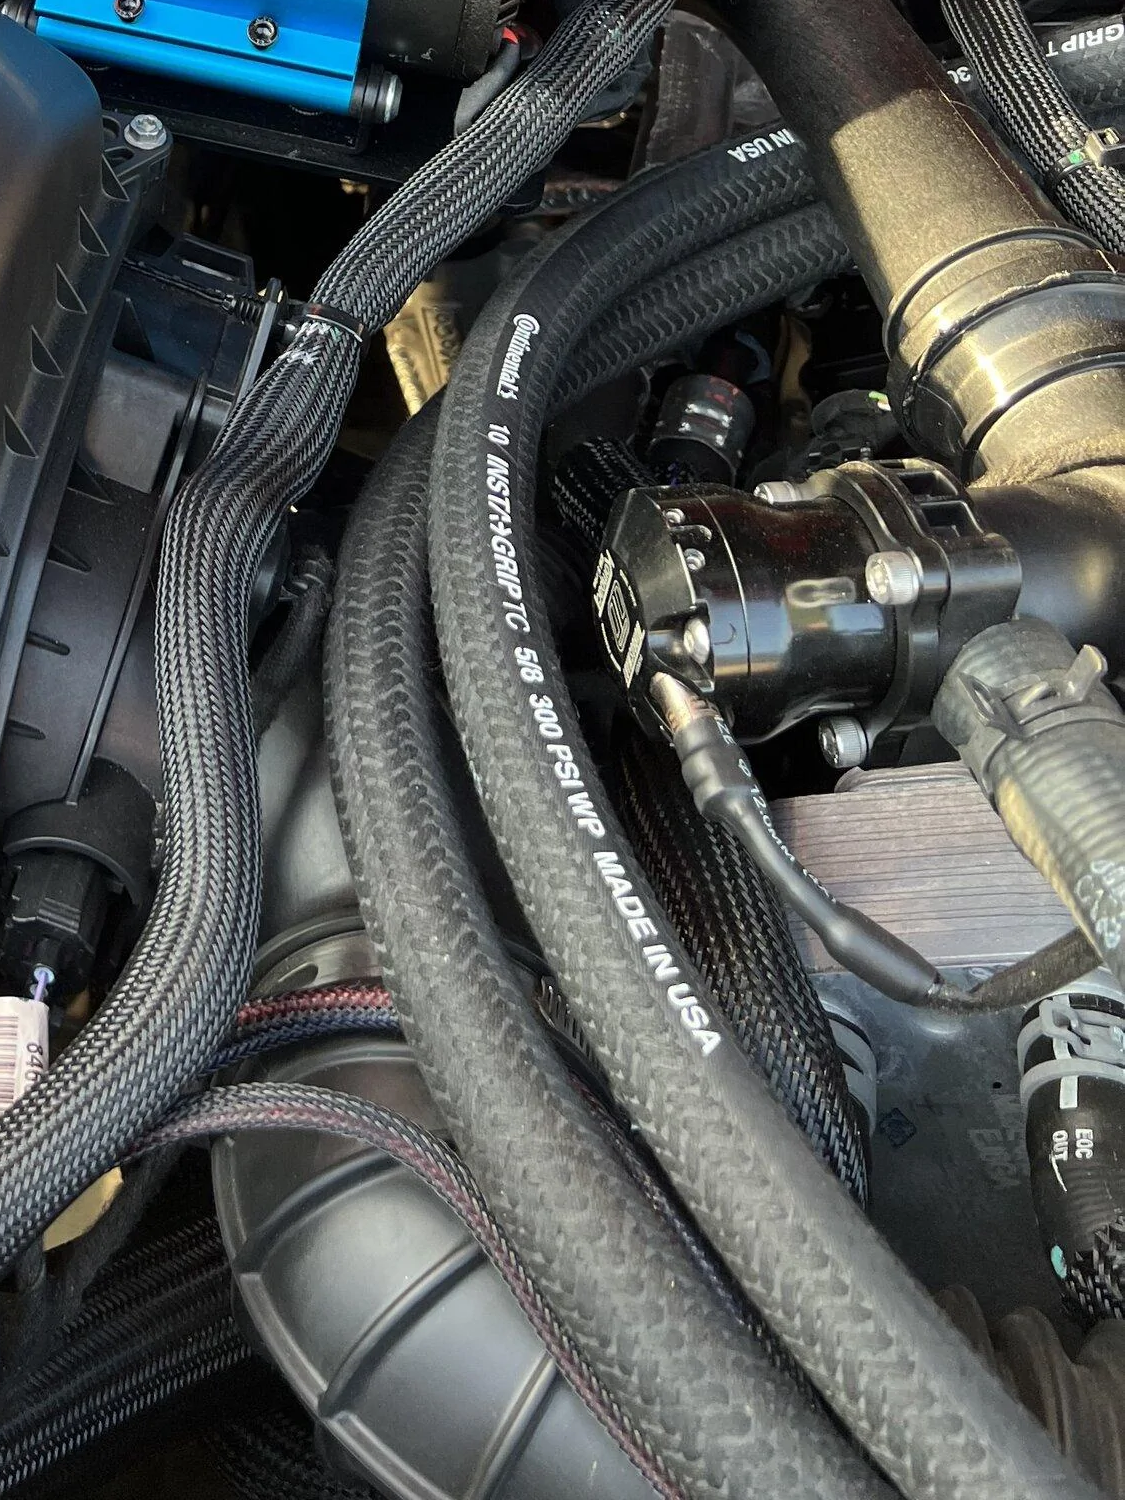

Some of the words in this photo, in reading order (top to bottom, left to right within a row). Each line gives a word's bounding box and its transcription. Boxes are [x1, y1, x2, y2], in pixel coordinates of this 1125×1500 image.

[727, 137, 774, 163] USA
[487, 423, 511, 446] 10
[502, 601, 531, 633] TC
[514, 646, 545, 684] 5/8
[529, 693, 564, 740] 300
[547, 744, 585, 789] PSI
[568, 791, 606, 838] WP
[593, 851, 658, 942] MADE
[643, 944, 680, 982] IN
[667, 982, 721, 1057] USA
[1052, 1130, 1069, 1161] OUT
[1075, 1128, 1094, 1159] EOC
